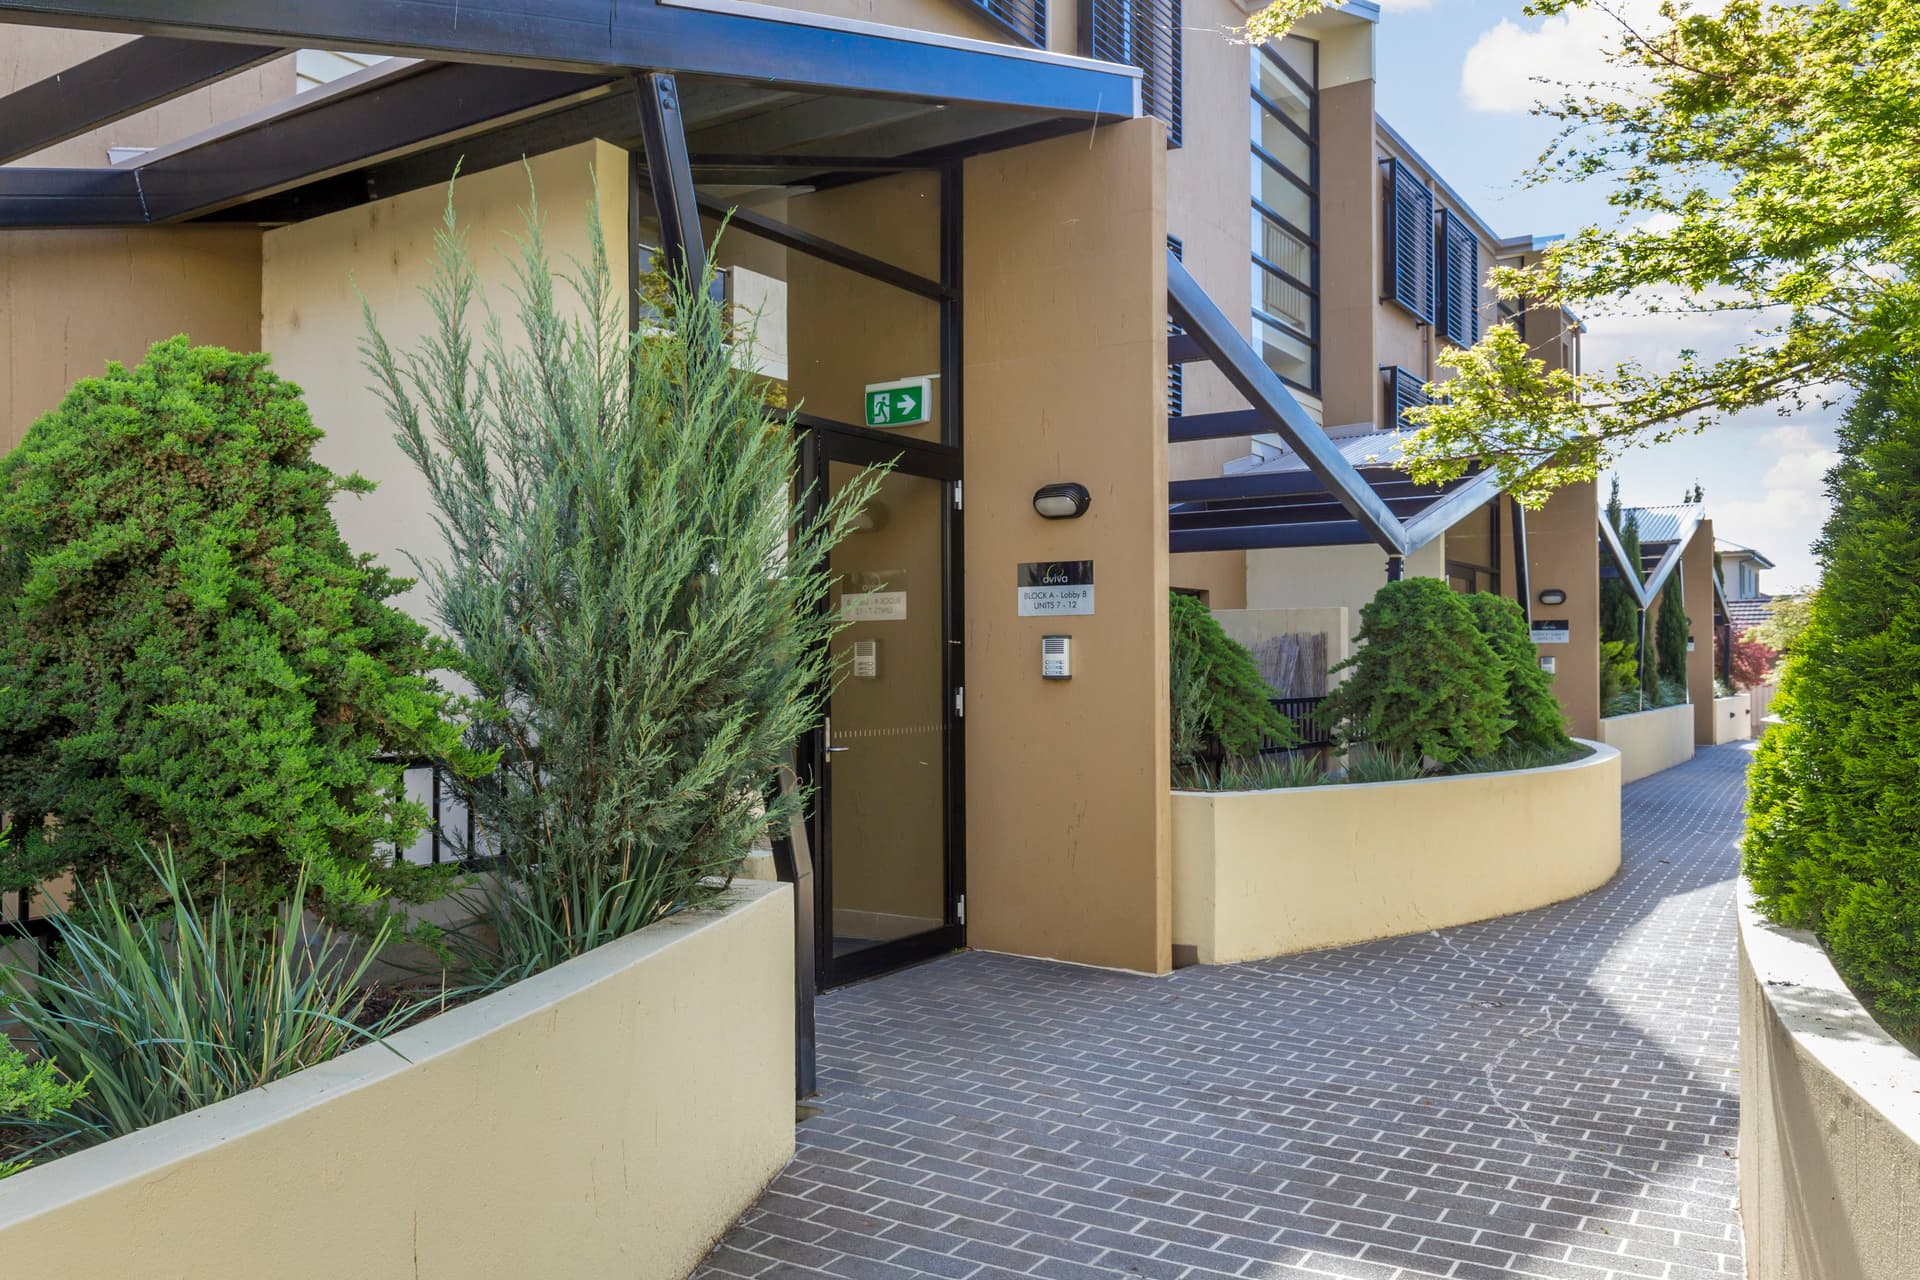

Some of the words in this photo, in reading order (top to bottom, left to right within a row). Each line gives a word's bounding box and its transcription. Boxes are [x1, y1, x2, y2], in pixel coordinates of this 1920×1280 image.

[1042, 576, 1068, 584] aviva
[1024, 592, 1047, 600] BLOCK
[1060, 590, 1081, 600] Lobby
[1034, 602, 1055, 610] UNITS
